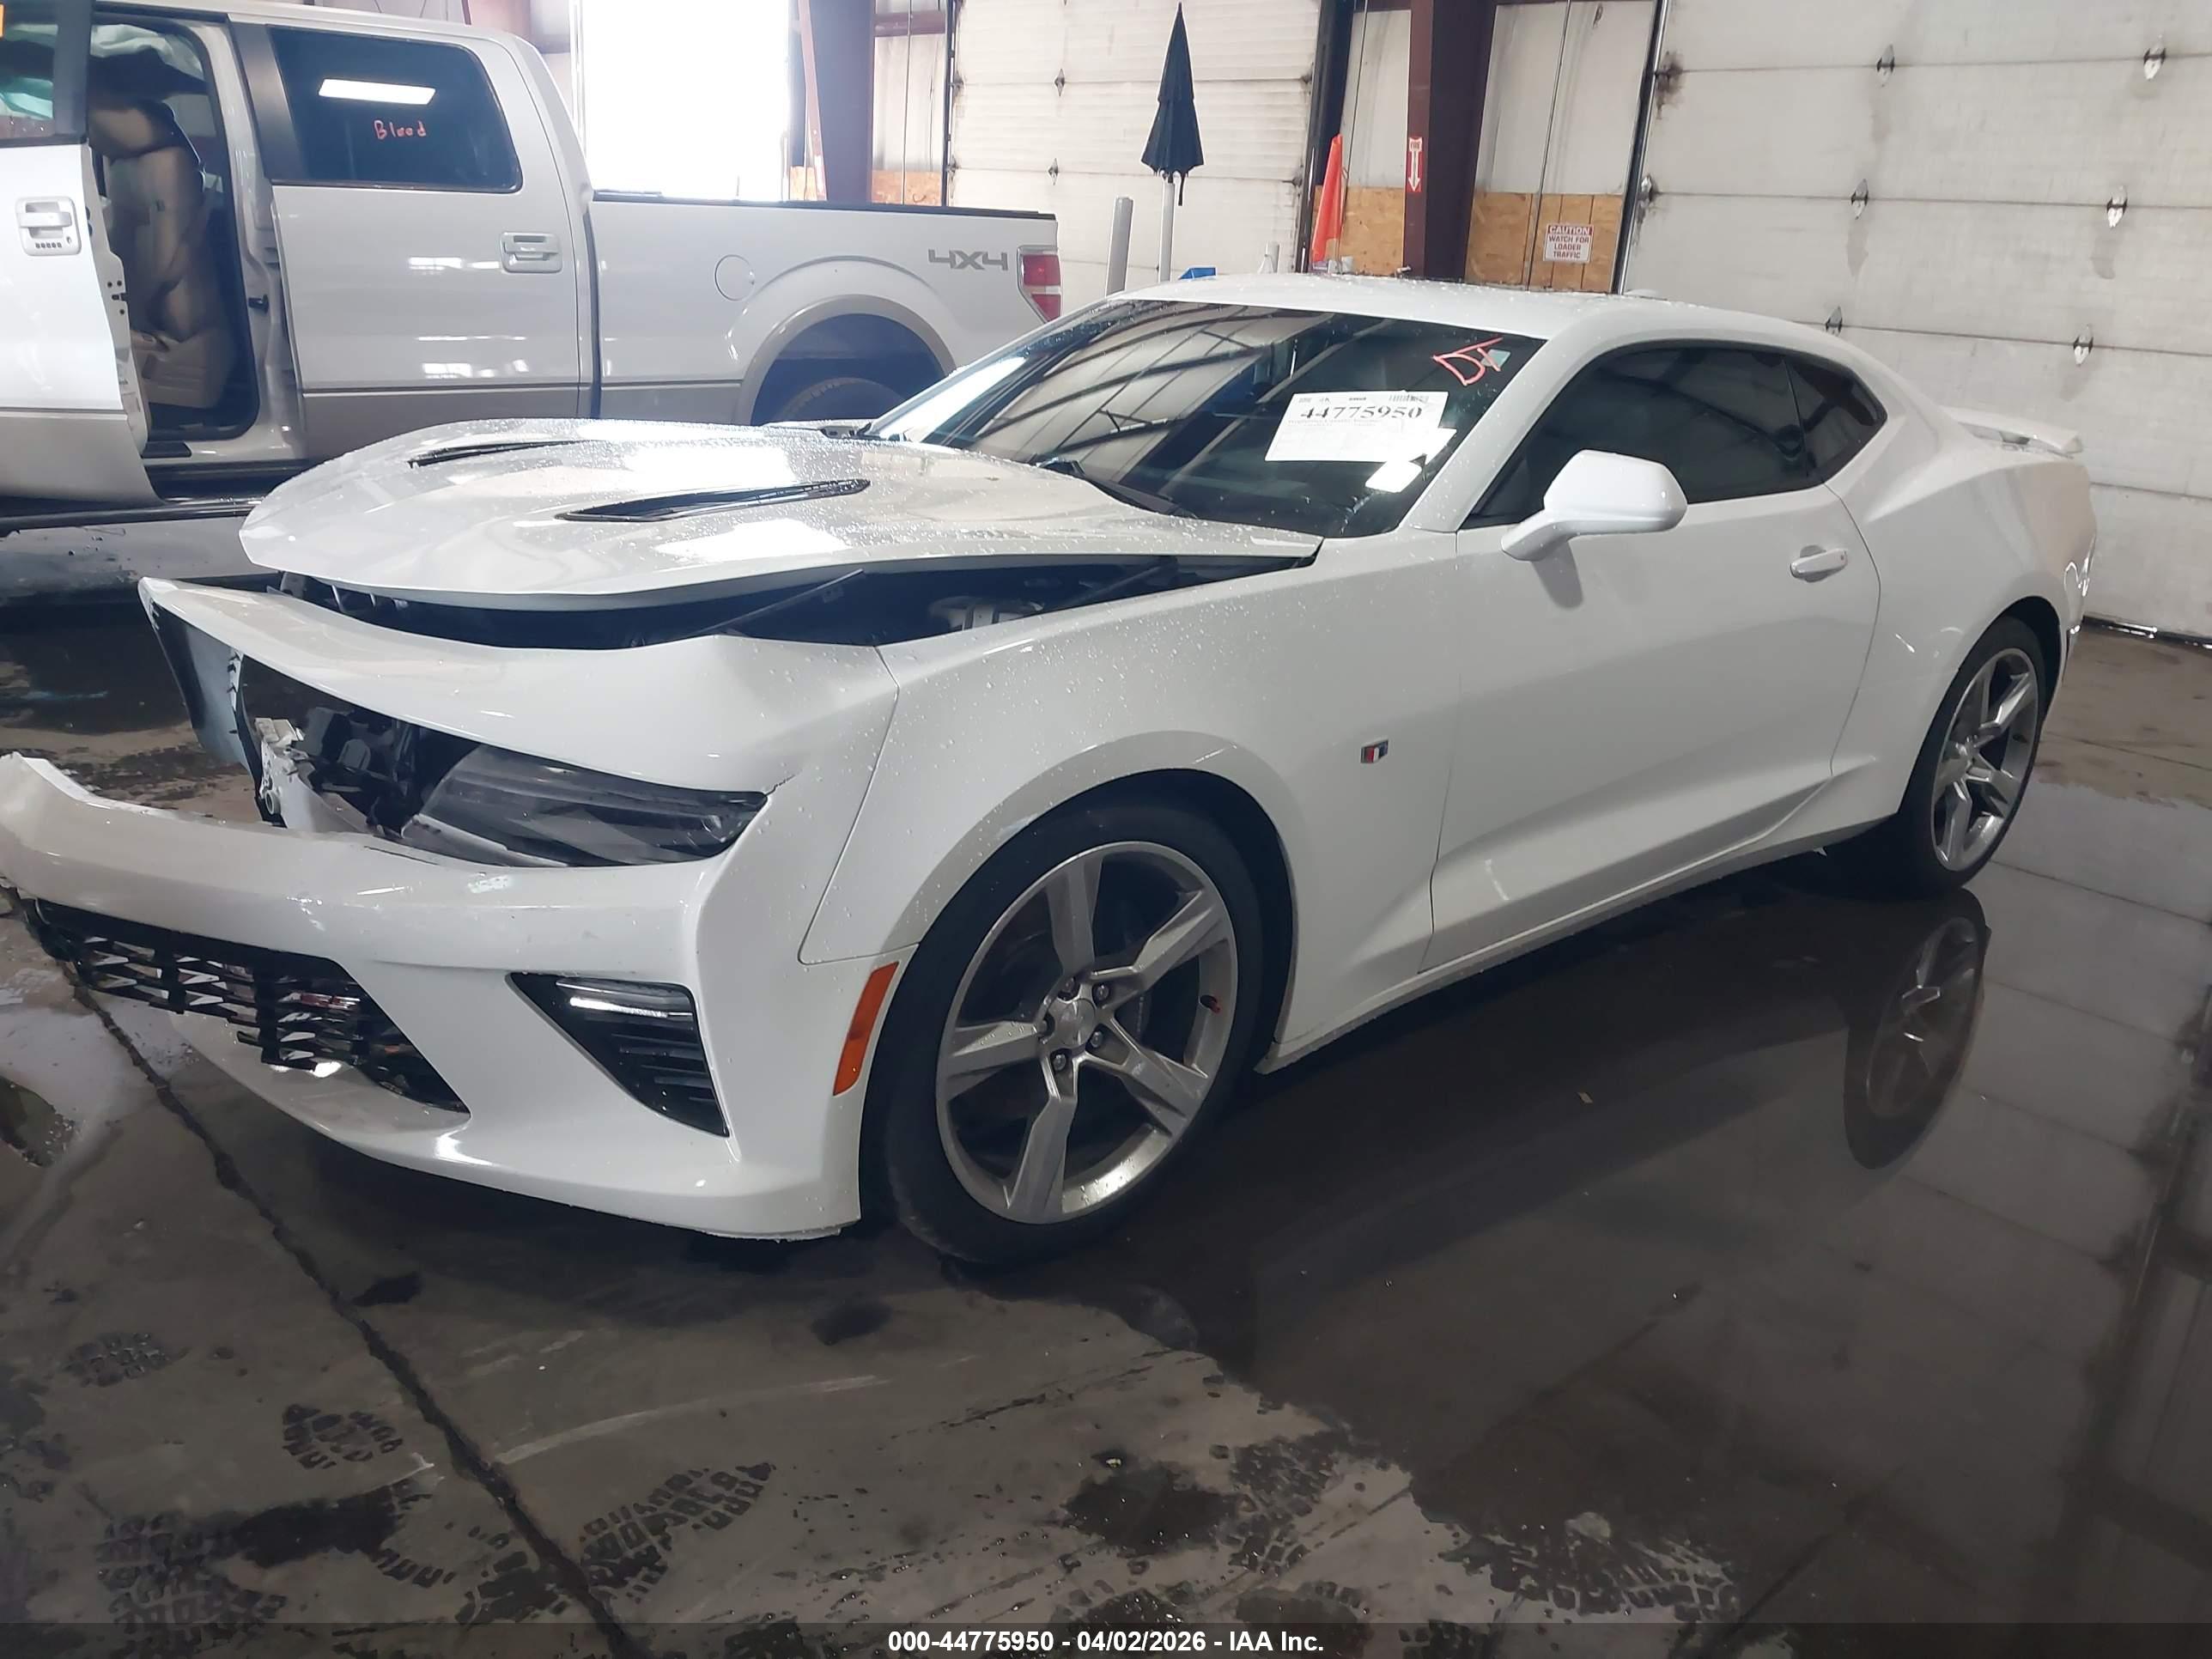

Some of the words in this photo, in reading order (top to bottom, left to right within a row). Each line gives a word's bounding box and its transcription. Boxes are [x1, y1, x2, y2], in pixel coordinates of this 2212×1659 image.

[374, 119, 427, 140] Blood
[1549, 225, 1590, 234] CAUTION
[1301, 405, 1423, 419] 44775950
